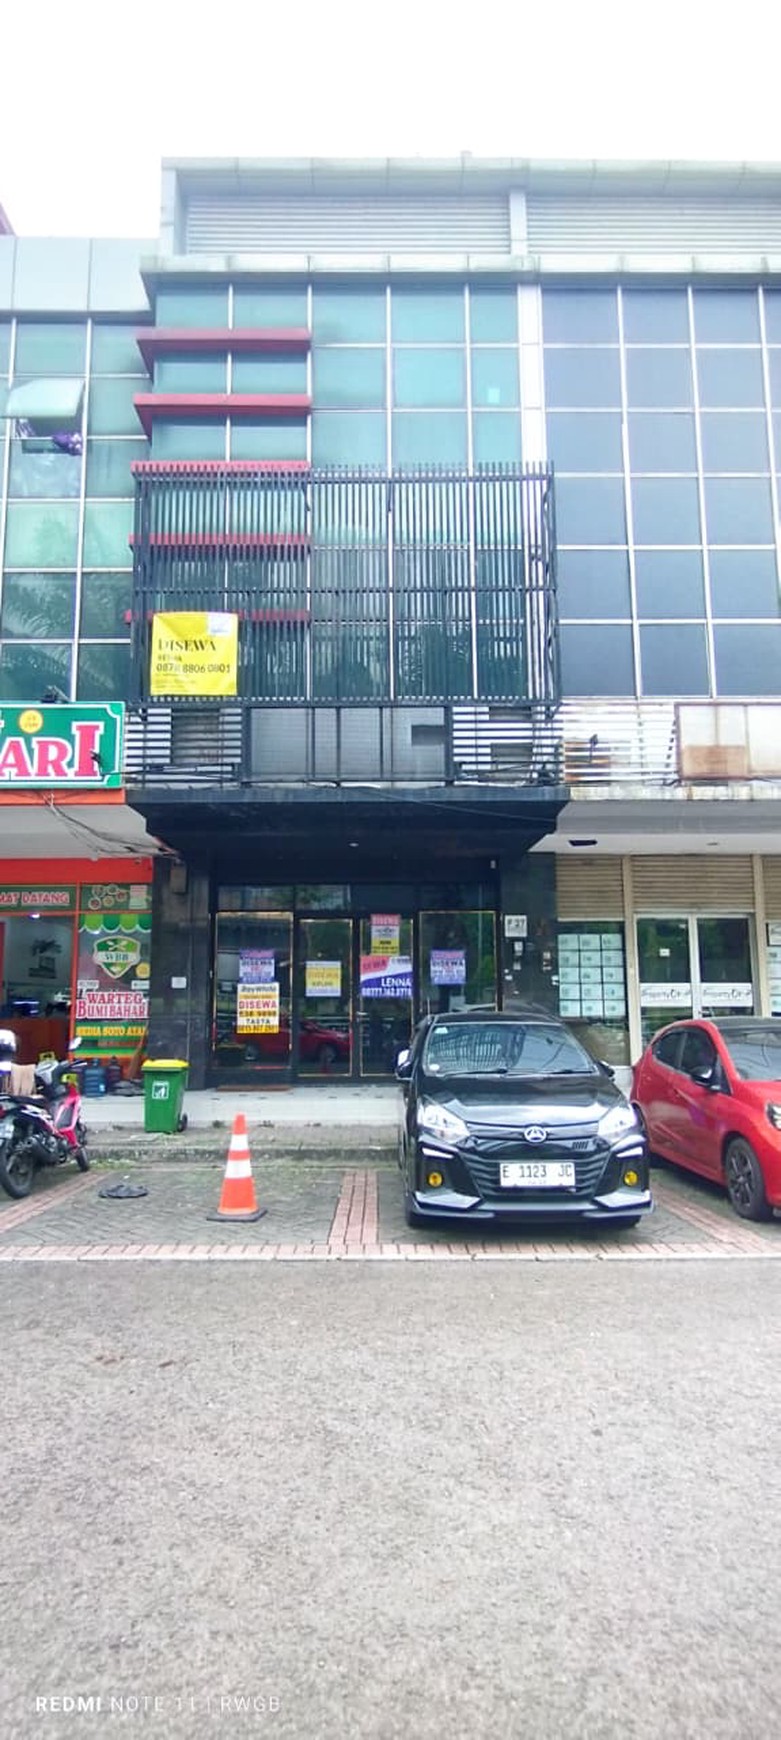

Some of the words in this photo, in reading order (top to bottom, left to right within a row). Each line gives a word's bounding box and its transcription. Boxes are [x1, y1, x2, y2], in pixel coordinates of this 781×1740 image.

[157, 638, 217, 652] DISEWA
[0, 721, 104, 779] ARI
[22, 891, 70, 903] DATANG
[381, 977, 413, 988] LENNA
[86, 992, 144, 1004] WARTEG
[239, 1000, 278, 1009] DISEWA
[502, 1165, 510, 1178] E
[519, 1164, 547, 1178] 1123
[558, 1164, 572, 1177] JC
